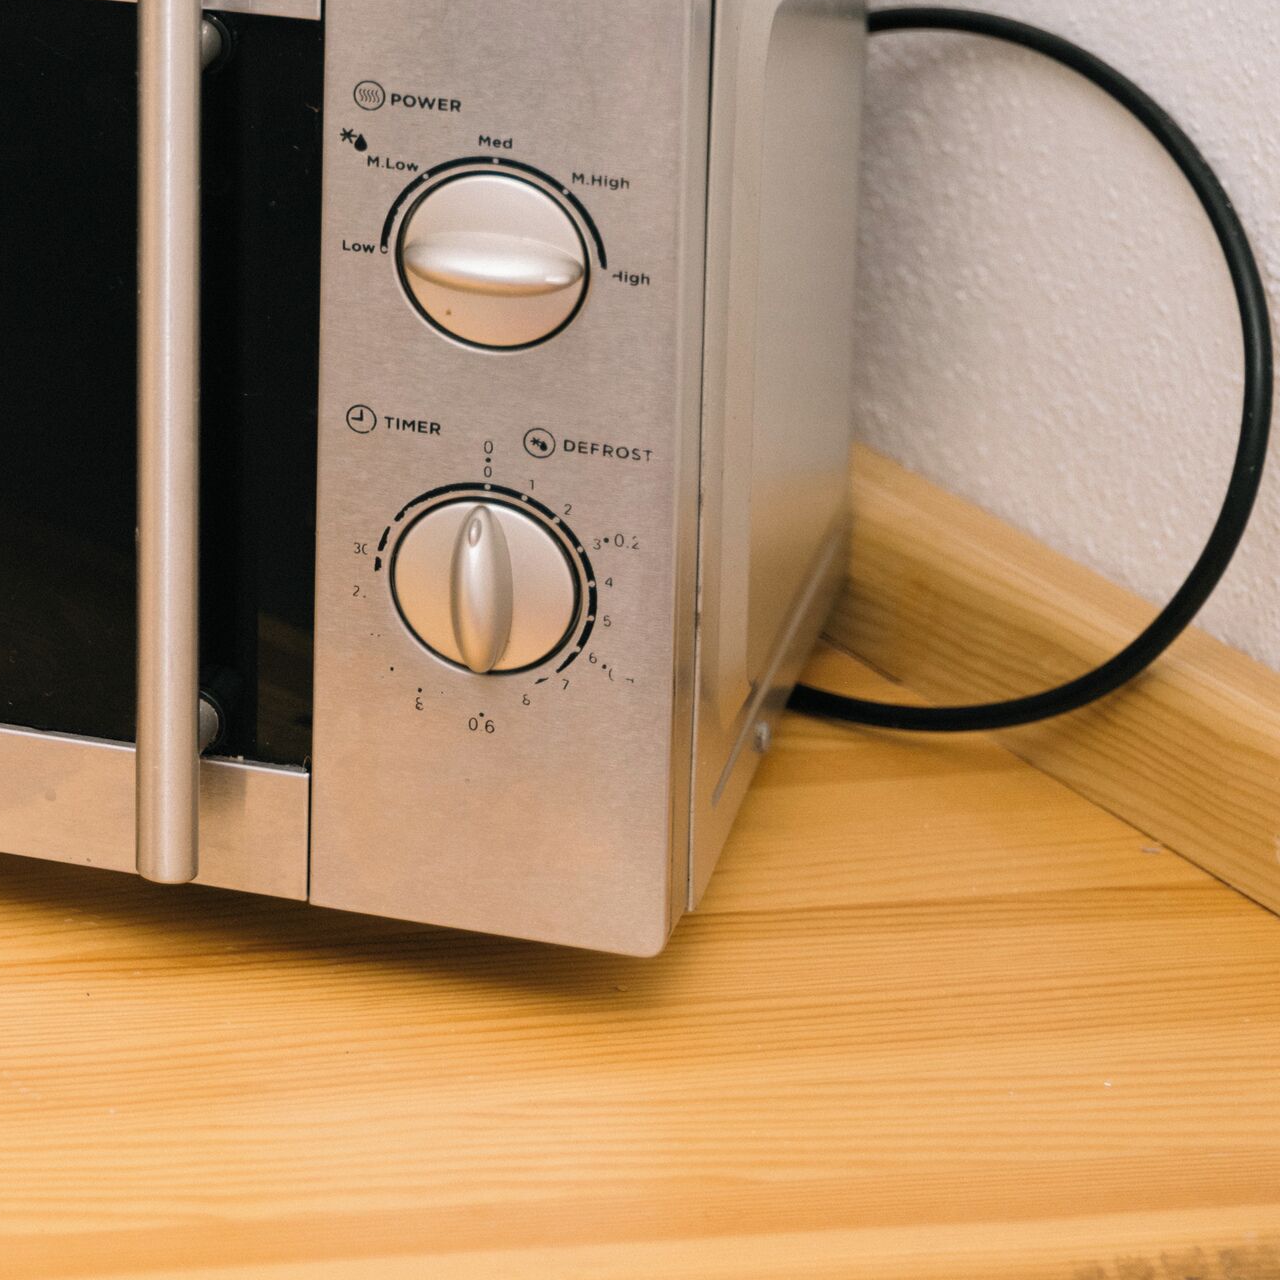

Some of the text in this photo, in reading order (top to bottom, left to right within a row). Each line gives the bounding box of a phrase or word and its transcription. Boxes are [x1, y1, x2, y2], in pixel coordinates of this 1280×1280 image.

[391, 93, 461, 113] POWER
[478, 135, 513, 150] Med
[367, 155, 419, 172] M.Low
[571, 172, 630, 190] M.High
[342, 240, 375, 254] Low
[384, 416, 441, 435] TIMER
[483, 440, 494, 455] 0
[563, 439, 653, 461] DEFROST
[483, 466, 493, 478] 0
[529, 479, 535, 490] 1
[563, 503, 573, 516] 2
[592, 538, 602, 550] 3
[604, 577, 613, 588] 4
[602, 615, 612, 627] 5
